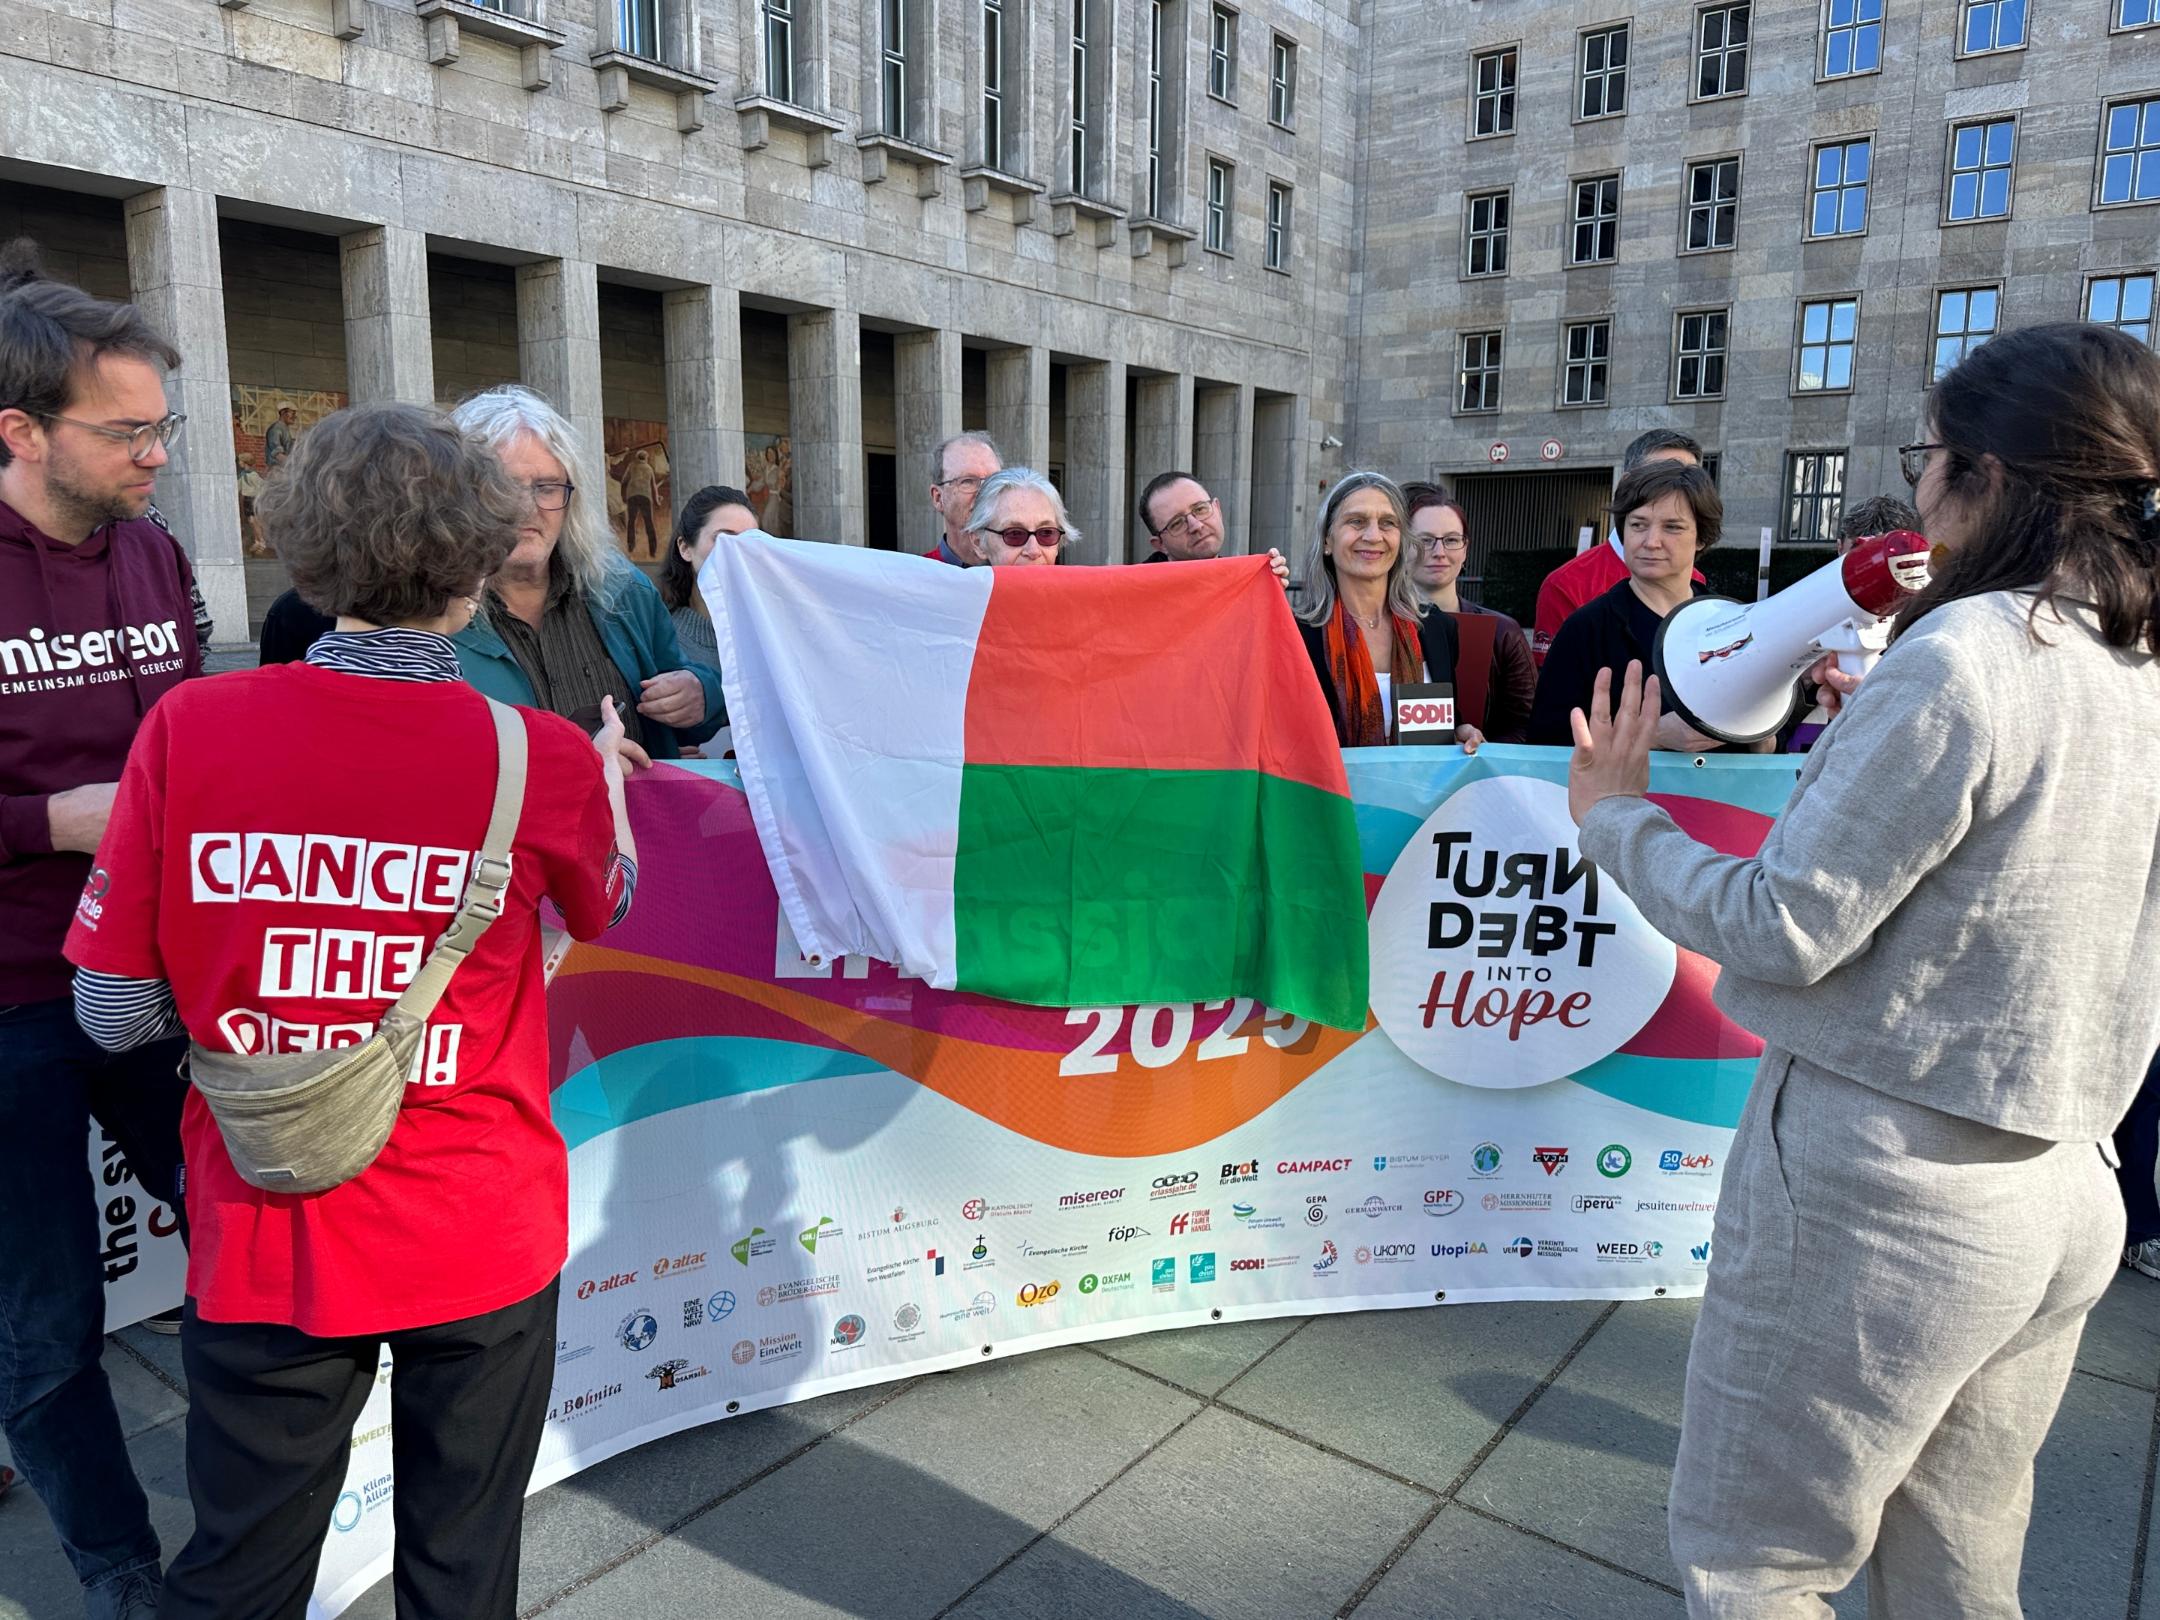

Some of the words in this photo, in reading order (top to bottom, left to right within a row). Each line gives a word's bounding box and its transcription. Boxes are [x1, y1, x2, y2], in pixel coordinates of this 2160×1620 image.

[0, 620, 179, 675] misereor
[1, 675, 85, 695] EMEINSAM
[90, 667, 134, 684] GLOBAL
[1399, 703, 1453, 725] SODI!
[195, 836, 512, 914] CANCE
[1432, 831, 1599, 916] TURN
[1427, 902, 1616, 968] DEBT
[262, 930, 424, 998] THE
[1487, 966, 1552, 982] INTO
[1418, 970, 1592, 1041] Hope
[1058, 998, 1312, 1077] 2025
[1663, 1152, 1679, 1163] 50
[1221, 1159, 1258, 1177] Brot
[1277, 1159, 1352, 1174] CAMPACT
[1242, 1174, 1258, 1182] Welt
[1059, 1187, 1126, 1206] misereor
[1150, 1183, 1197, 1197] erlassjahr.de
[1424, 1190, 1453, 1203] GPF
[1306, 1196, 1327, 1204] GEPA
[1635, 1200, 1716, 1212] jesuitenweltwei
[1191, 1209, 1210, 1217] FORUM
[1345, 1205, 1402, 1214] GERMANWATCH
[1191, 1217, 1210, 1225] FAIRER
[1191, 1224, 1211, 1233] HANDEL
[859, 1229, 890, 1241] BISTUM
[894, 1218, 939, 1233] AUGSBURG
[100, 1196, 138, 1283] the
[1503, 1246, 1518, 1255] VEM
[1537, 1245, 1579, 1253] EVANGELISCHE
[1597, 1243, 1638, 1255] WEED
[672, 1252, 708, 1270] attac
[866, 1260, 902, 1274] Evangelische
[903, 1256, 920, 1266] Kirche
[1230, 1258, 1265, 1271] SODI!
[599, 1271, 639, 1293] attac
[778, 1274, 840, 1290] EVANGELISCHE
[867, 1275, 878, 1283] von
[879, 1269, 906, 1281] Westfalen
[1102, 1272, 1131, 1284] OXFAM
[684, 1298, 700, 1309] EINE
[684, 1304, 703, 1315] WELT
[684, 1312, 703, 1321] NETZ
[684, 1319, 702, 1328] NRW
[759, 1332, 796, 1347] Mission
[831, 1336, 846, 1345] NAD
[759, 1340, 802, 1358] EineWelt
[564, 1383, 622, 1415] Bohnita
[363, 1473, 393, 1494] Klima
[365, 1484, 394, 1506] Allian
